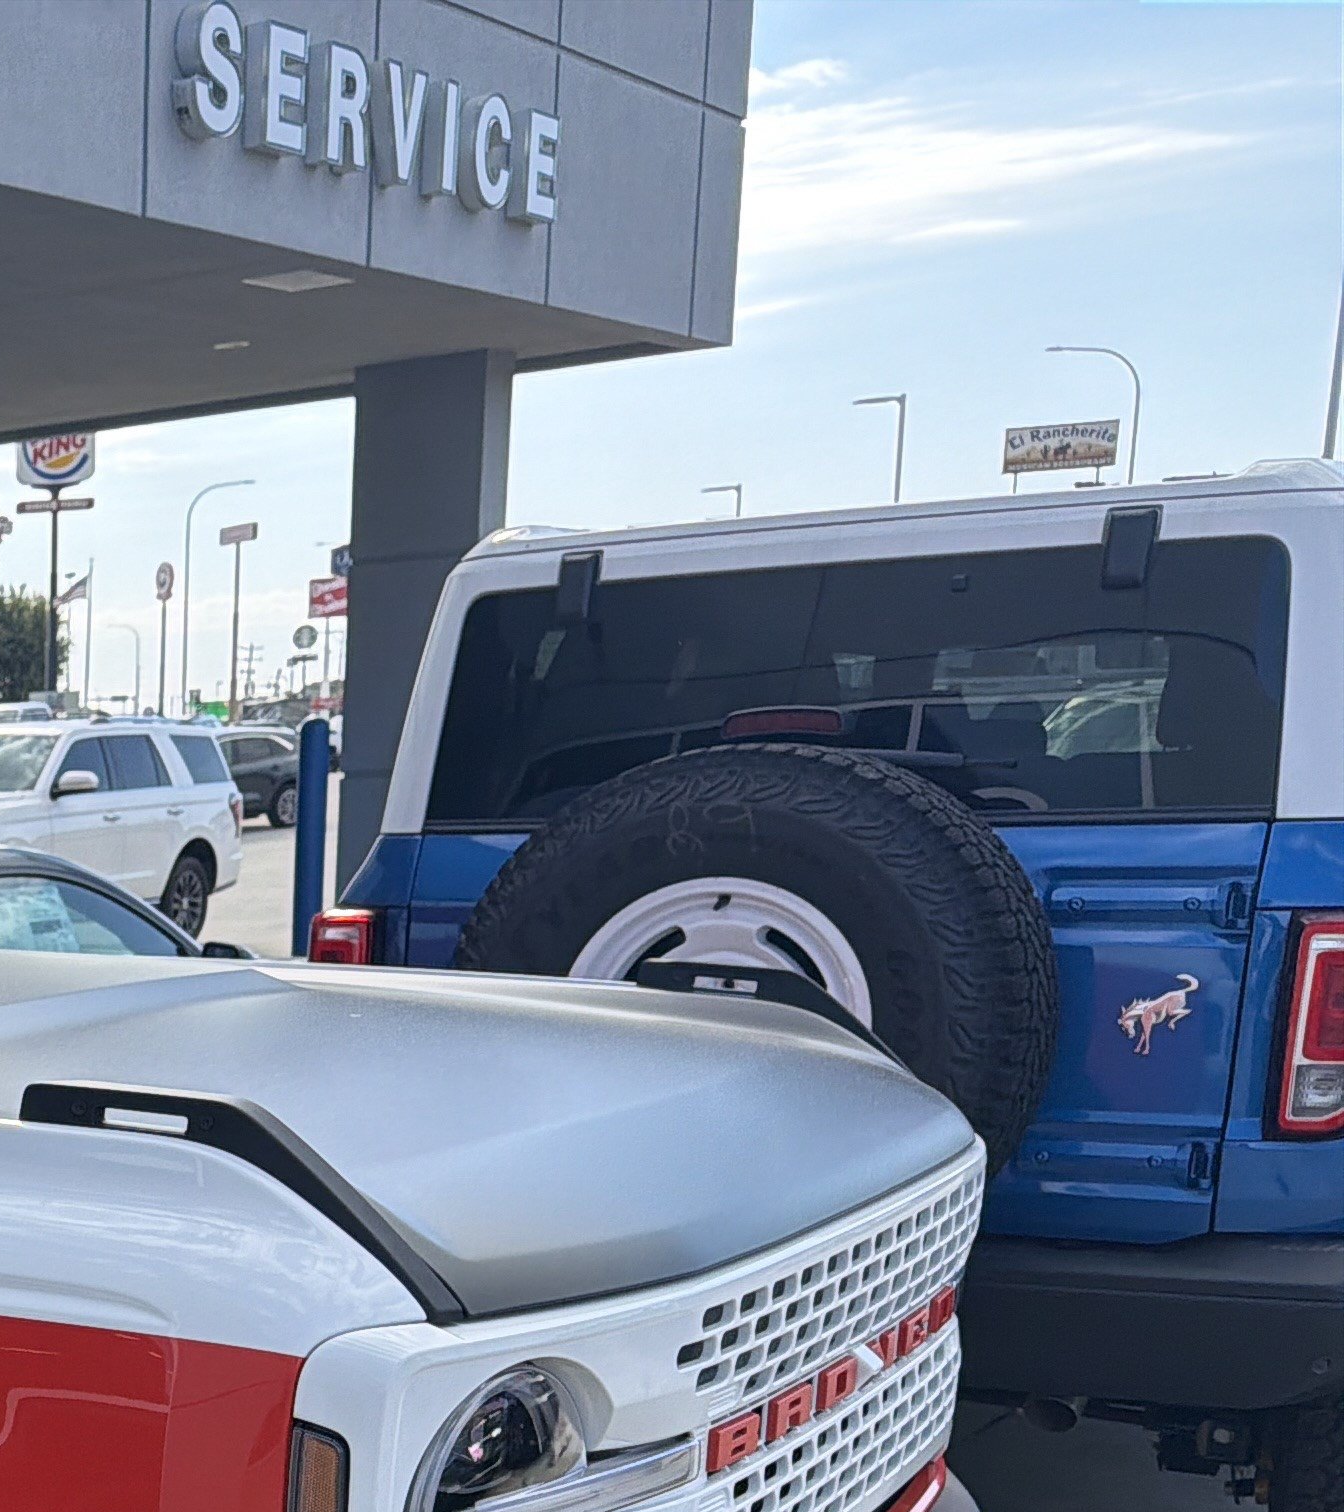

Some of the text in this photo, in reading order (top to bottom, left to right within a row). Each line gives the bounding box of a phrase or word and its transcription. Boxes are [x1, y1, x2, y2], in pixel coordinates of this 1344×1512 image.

[178, 1, 561, 223] SERVICE
[32, 433, 87, 467] KING
[1009, 433, 1025, 450] El
